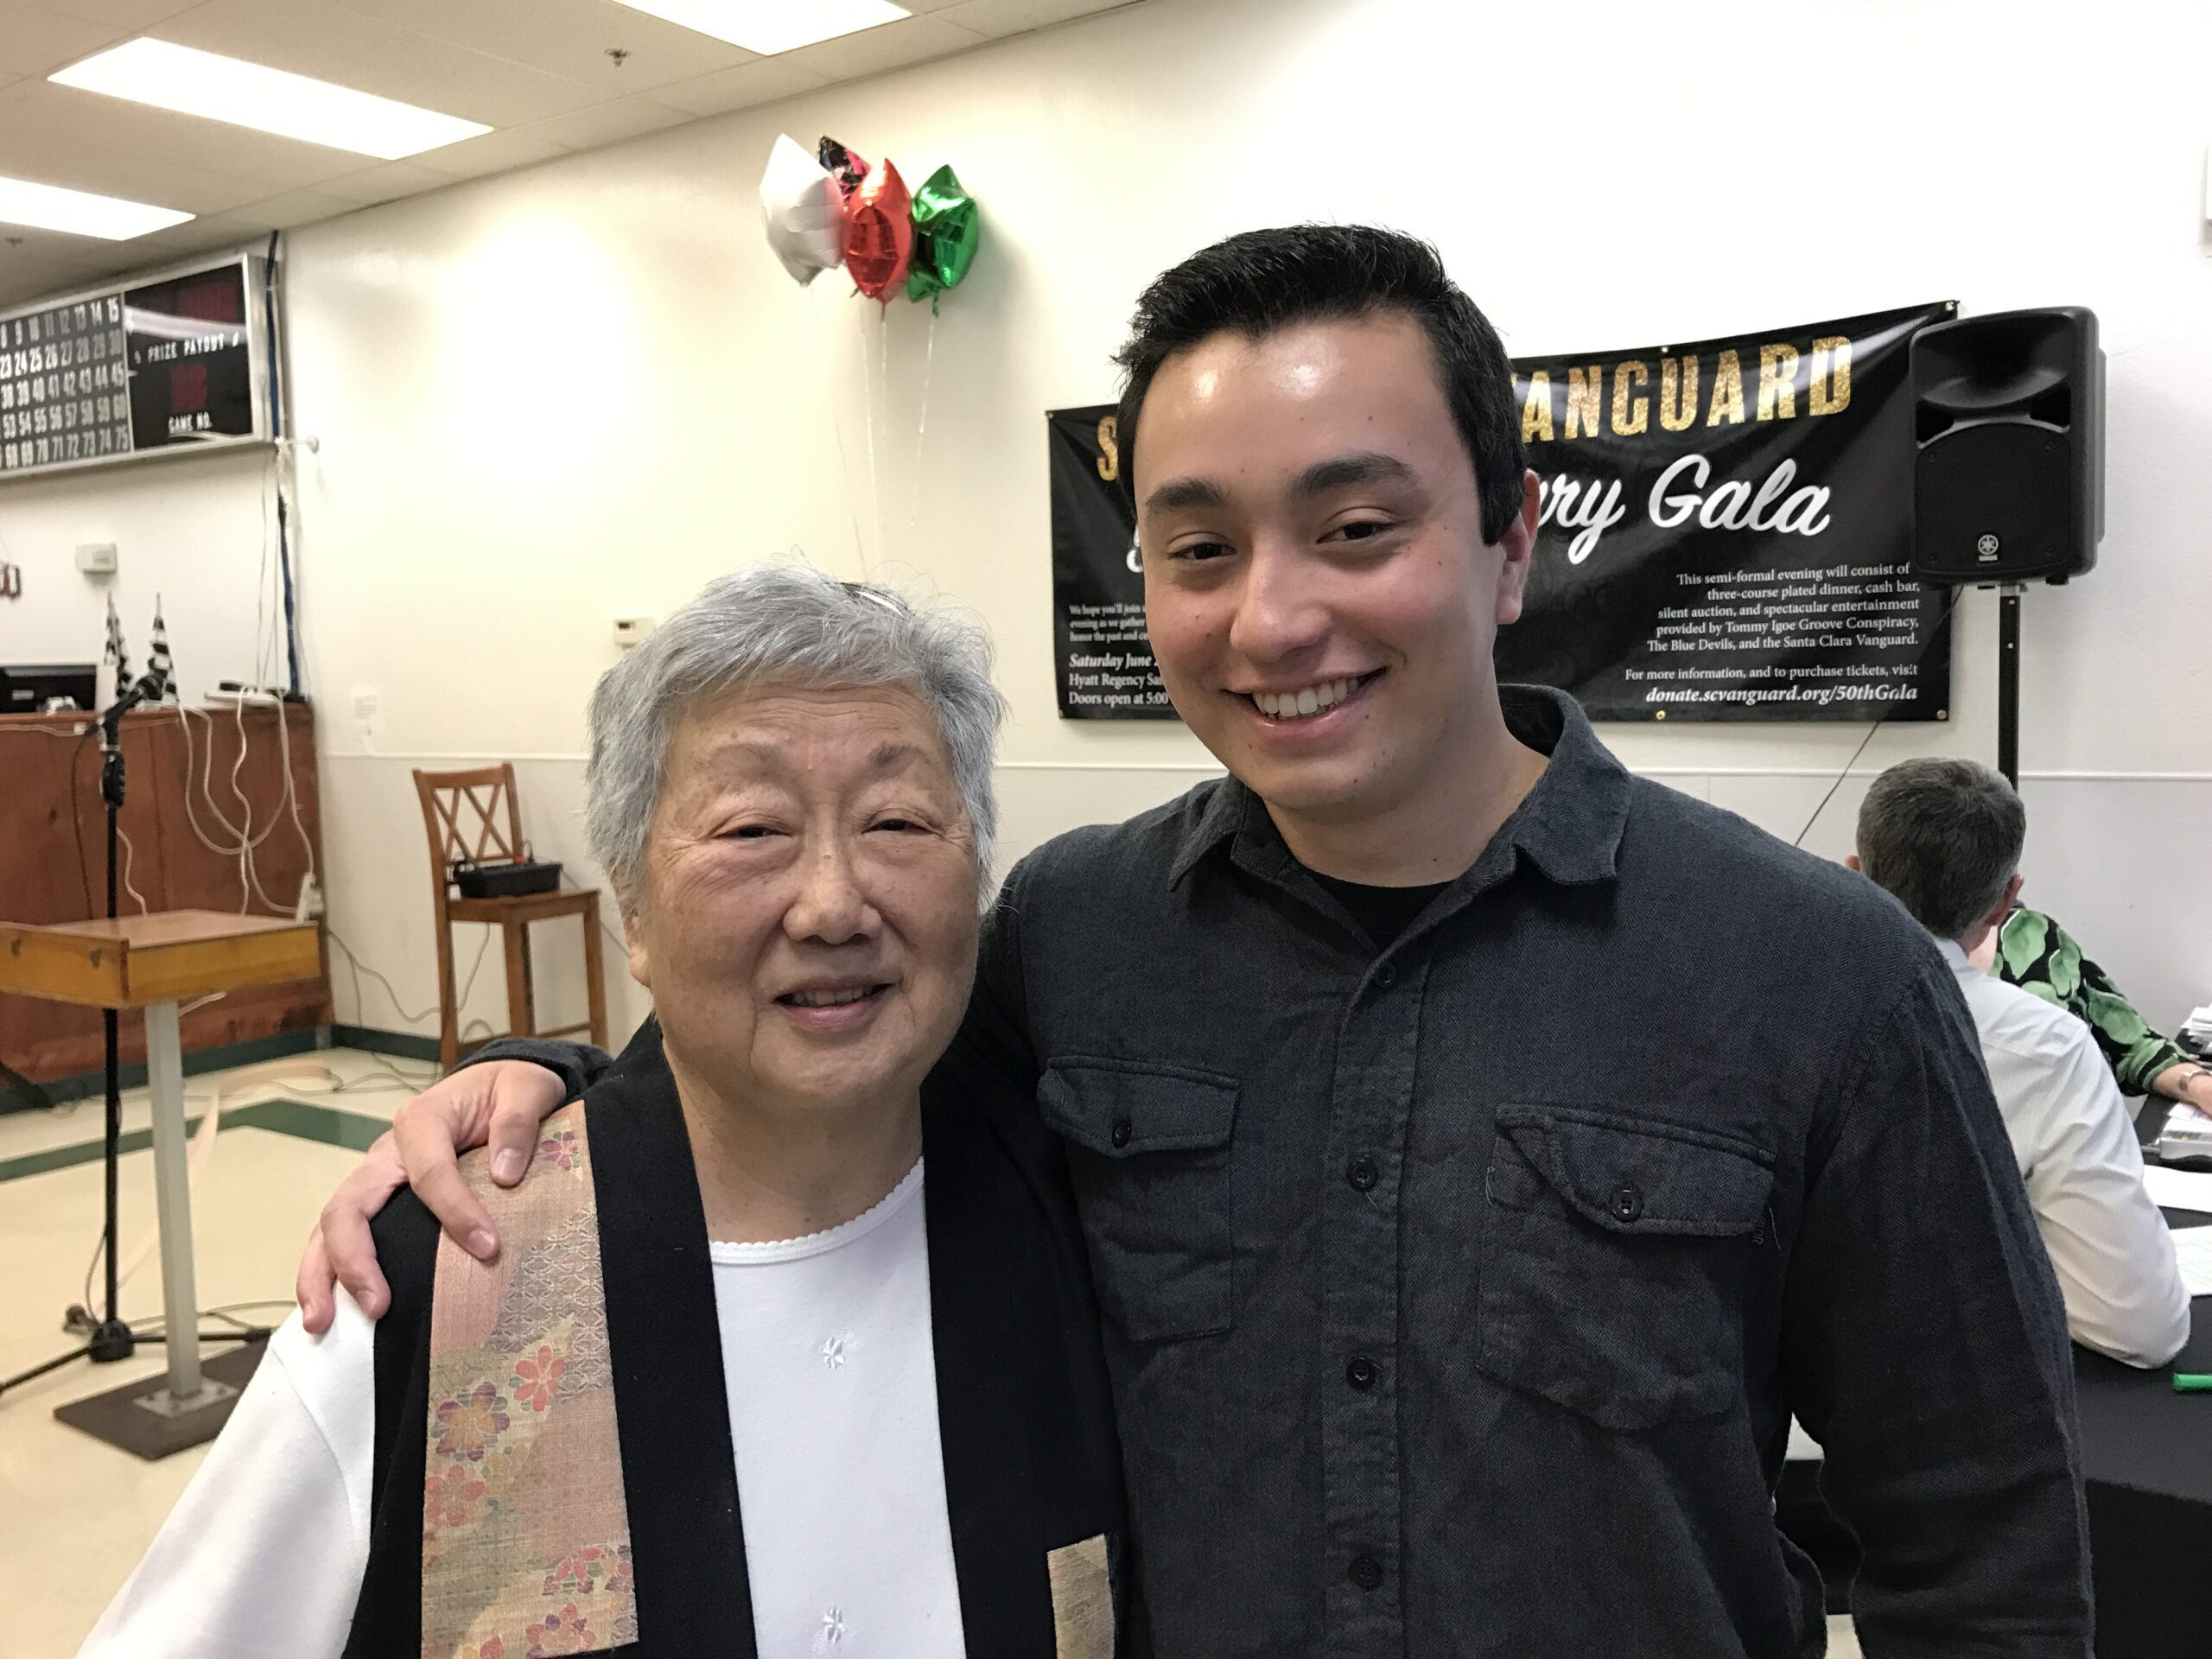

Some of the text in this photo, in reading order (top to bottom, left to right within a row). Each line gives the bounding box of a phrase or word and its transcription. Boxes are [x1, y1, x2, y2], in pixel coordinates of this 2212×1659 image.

[90, 301, 103, 327] 14
[107, 296, 119, 323] 15
[148, 341, 177, 363] PRIZE
[184, 333, 224, 357] PAYOUT
[0, 353, 12, 379] 23
[14, 350, 28, 377] 24
[29, 346, 42, 373] 25
[45, 342, 58, 370] 26
[60, 340, 73, 367] 27
[48, 373, 60, 398] 41
[63, 371, 76, 397] 42
[111, 360, 124, 388] 45
[1510, 335, 1852, 443] ANGUARD
[3, 412, 16, 439] 53
[19, 410, 32, 436] 54
[34, 406, 48, 434] 55
[65, 401, 78, 429] 57
[168, 414, 193, 434] GAME
[52, 435, 63, 461] 71
[67, 432, 79, 459] 72
[82, 429, 96, 456] 73
[99, 427, 111, 454] 74
[1648, 454, 1831, 537] Gala
[1676, 562, 1911, 586] This semi-formal evening will consist of
[1707, 580, 1921, 601] three-course plated dinner, cash bar,
[1657, 599, 1920, 619] silent auction, and spectacular entertainment
[1070, 619, 1098, 631] evening
[1122, 630, 1138, 641] and
[1656, 616, 1920, 639] provided by Tommy Igoe Groove Conspiracy,
[1647, 632, 1919, 652] The Blue Devils, and the Santa Clara Vanguard.
[1069, 652, 1152, 671] Saturday June
[1625, 668, 1644, 681] For
[1646, 671, 1675, 681] more
[1677, 666, 1746, 680] information,
[1749, 664, 1770, 678] and
[1774, 666, 1786, 677] to
[1789, 664, 1844, 681] purchase
[1847, 664, 1889, 677] tickets,
[1069, 672, 1099, 690] Hyatt
[1101, 671, 1146, 690] Regency
[1069, 690, 1169, 709] Doors open at 5:00
[1645, 683, 1917, 705] donate.scvanguard.org/50thGala
